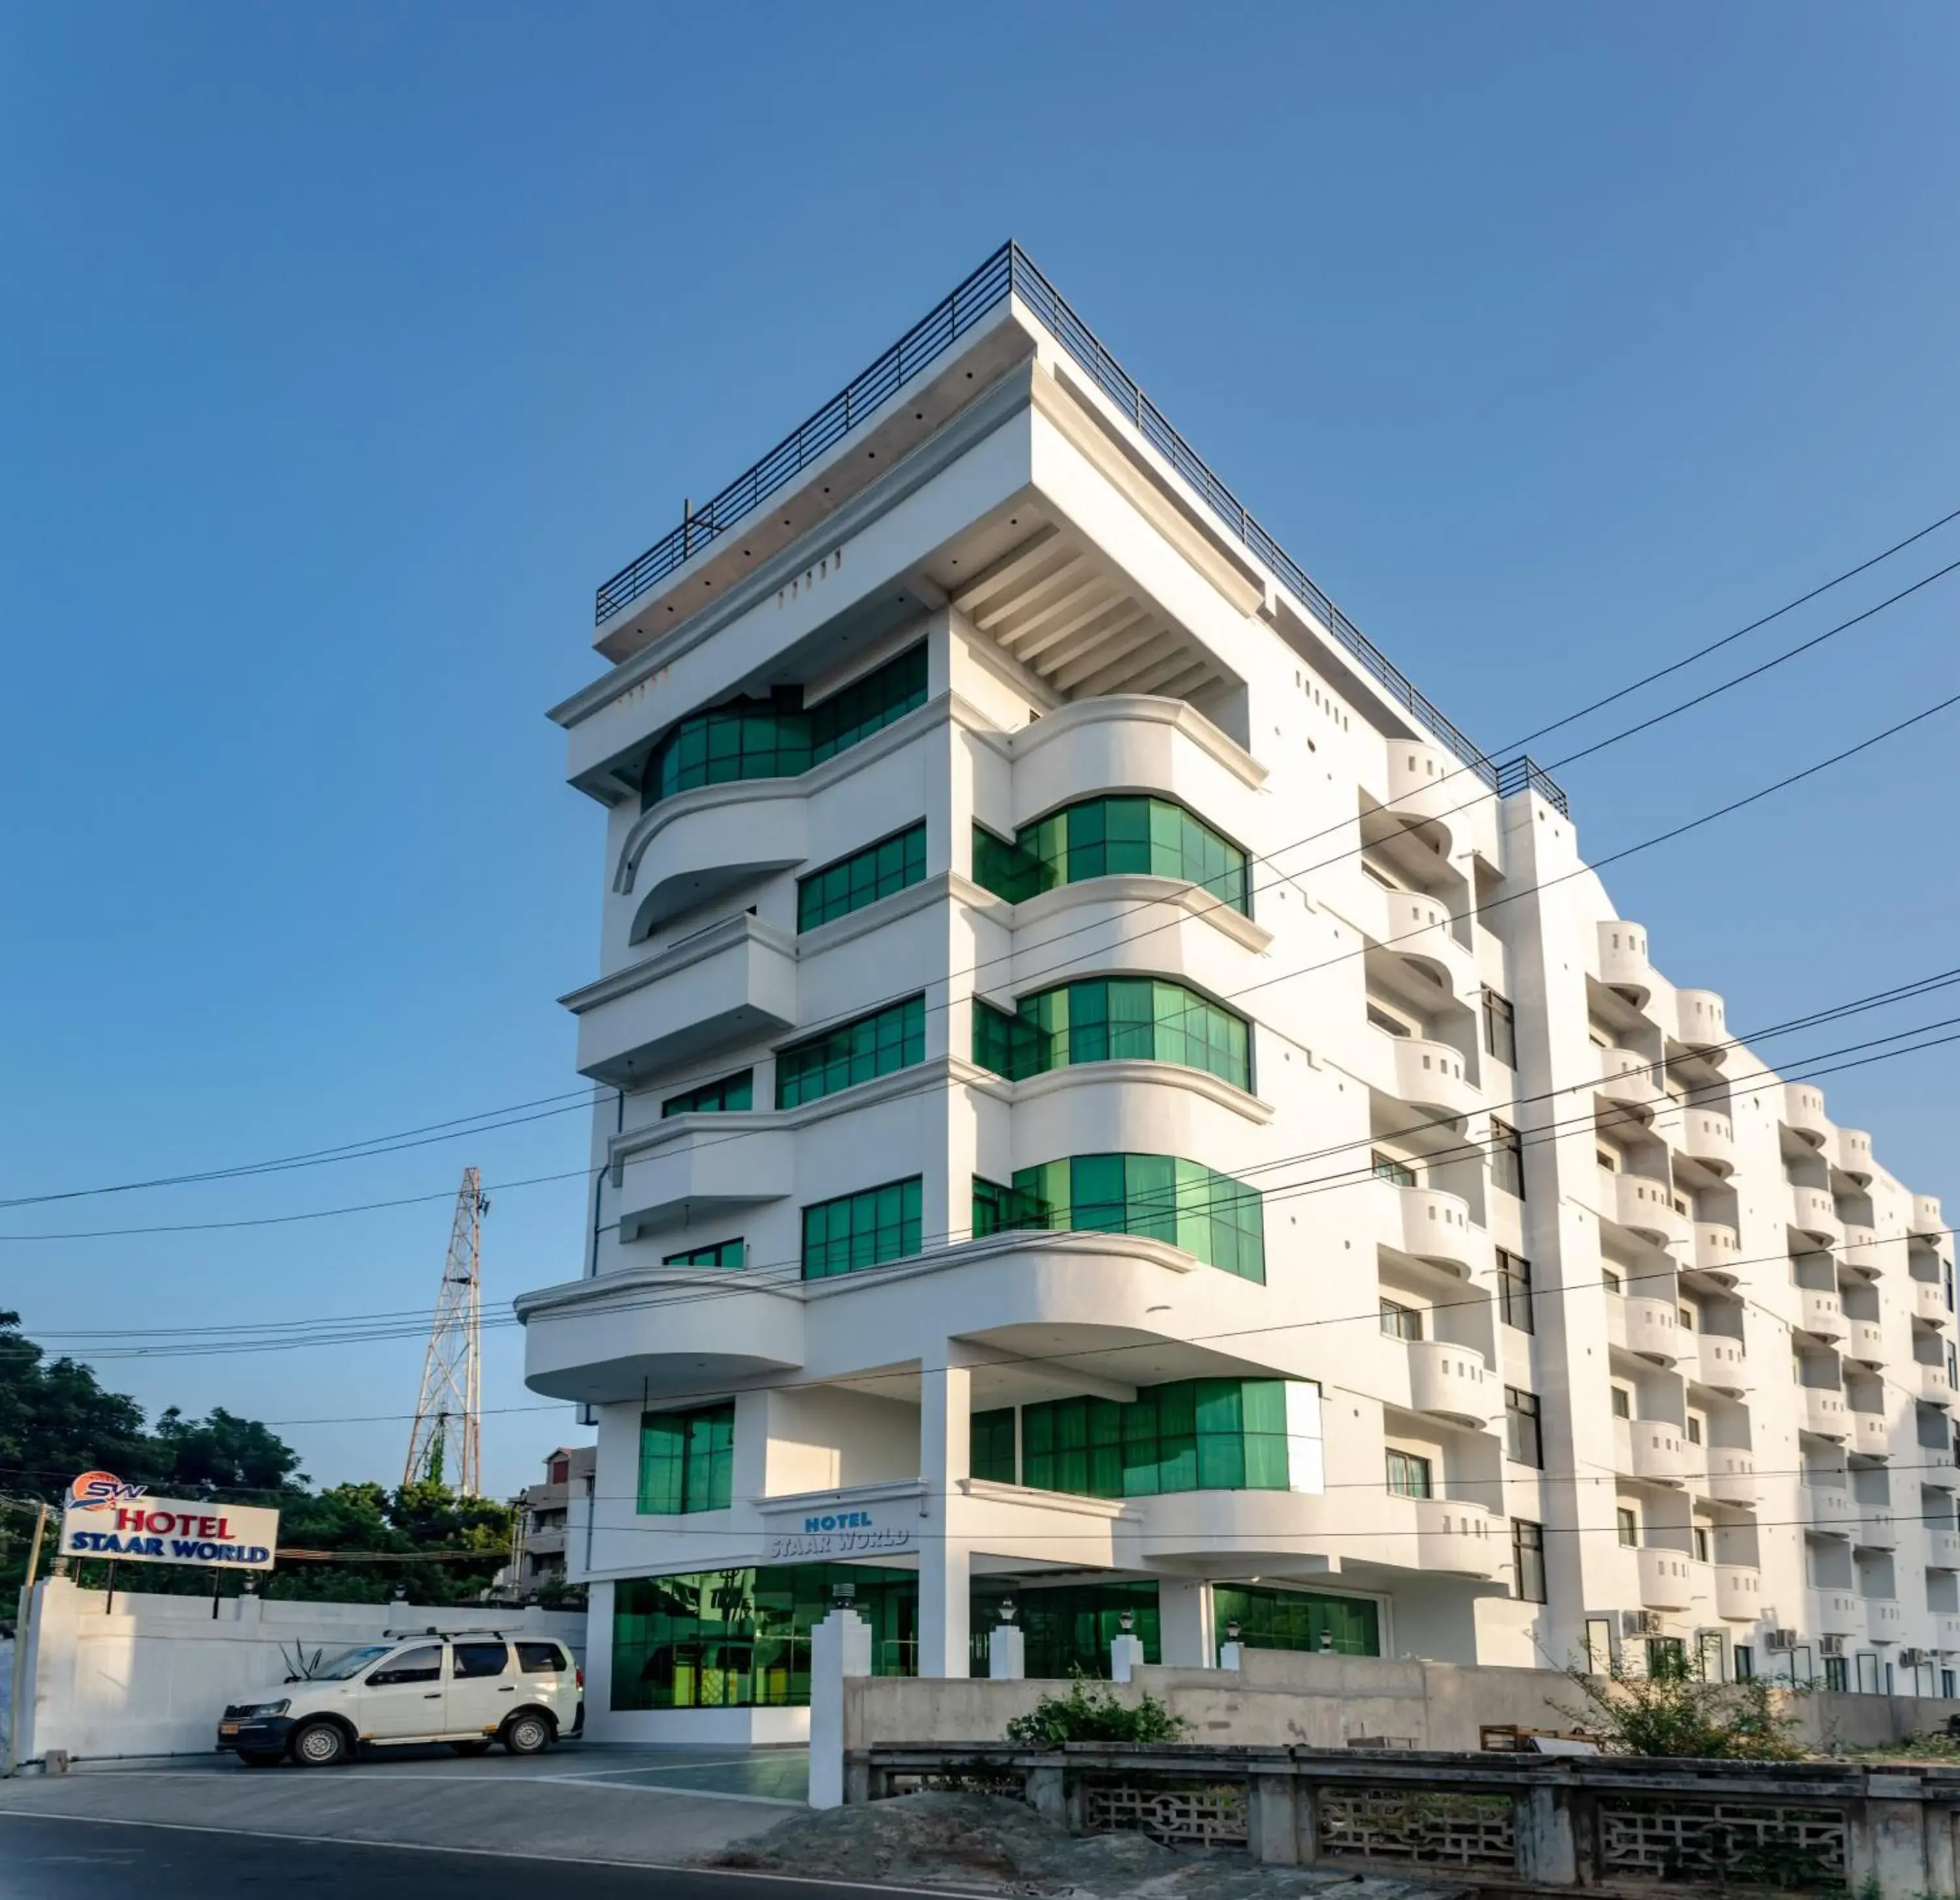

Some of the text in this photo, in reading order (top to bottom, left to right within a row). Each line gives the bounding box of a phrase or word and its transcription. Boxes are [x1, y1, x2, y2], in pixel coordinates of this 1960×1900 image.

[84, 1481, 148, 1498] SW
[116, 1508, 236, 1539] HOTEL
[804, 1512, 872, 1532] HOTEL
[72, 1531, 270, 1564] STAAR WORLD
[770, 1528, 909, 1558] STAAR WORLD
